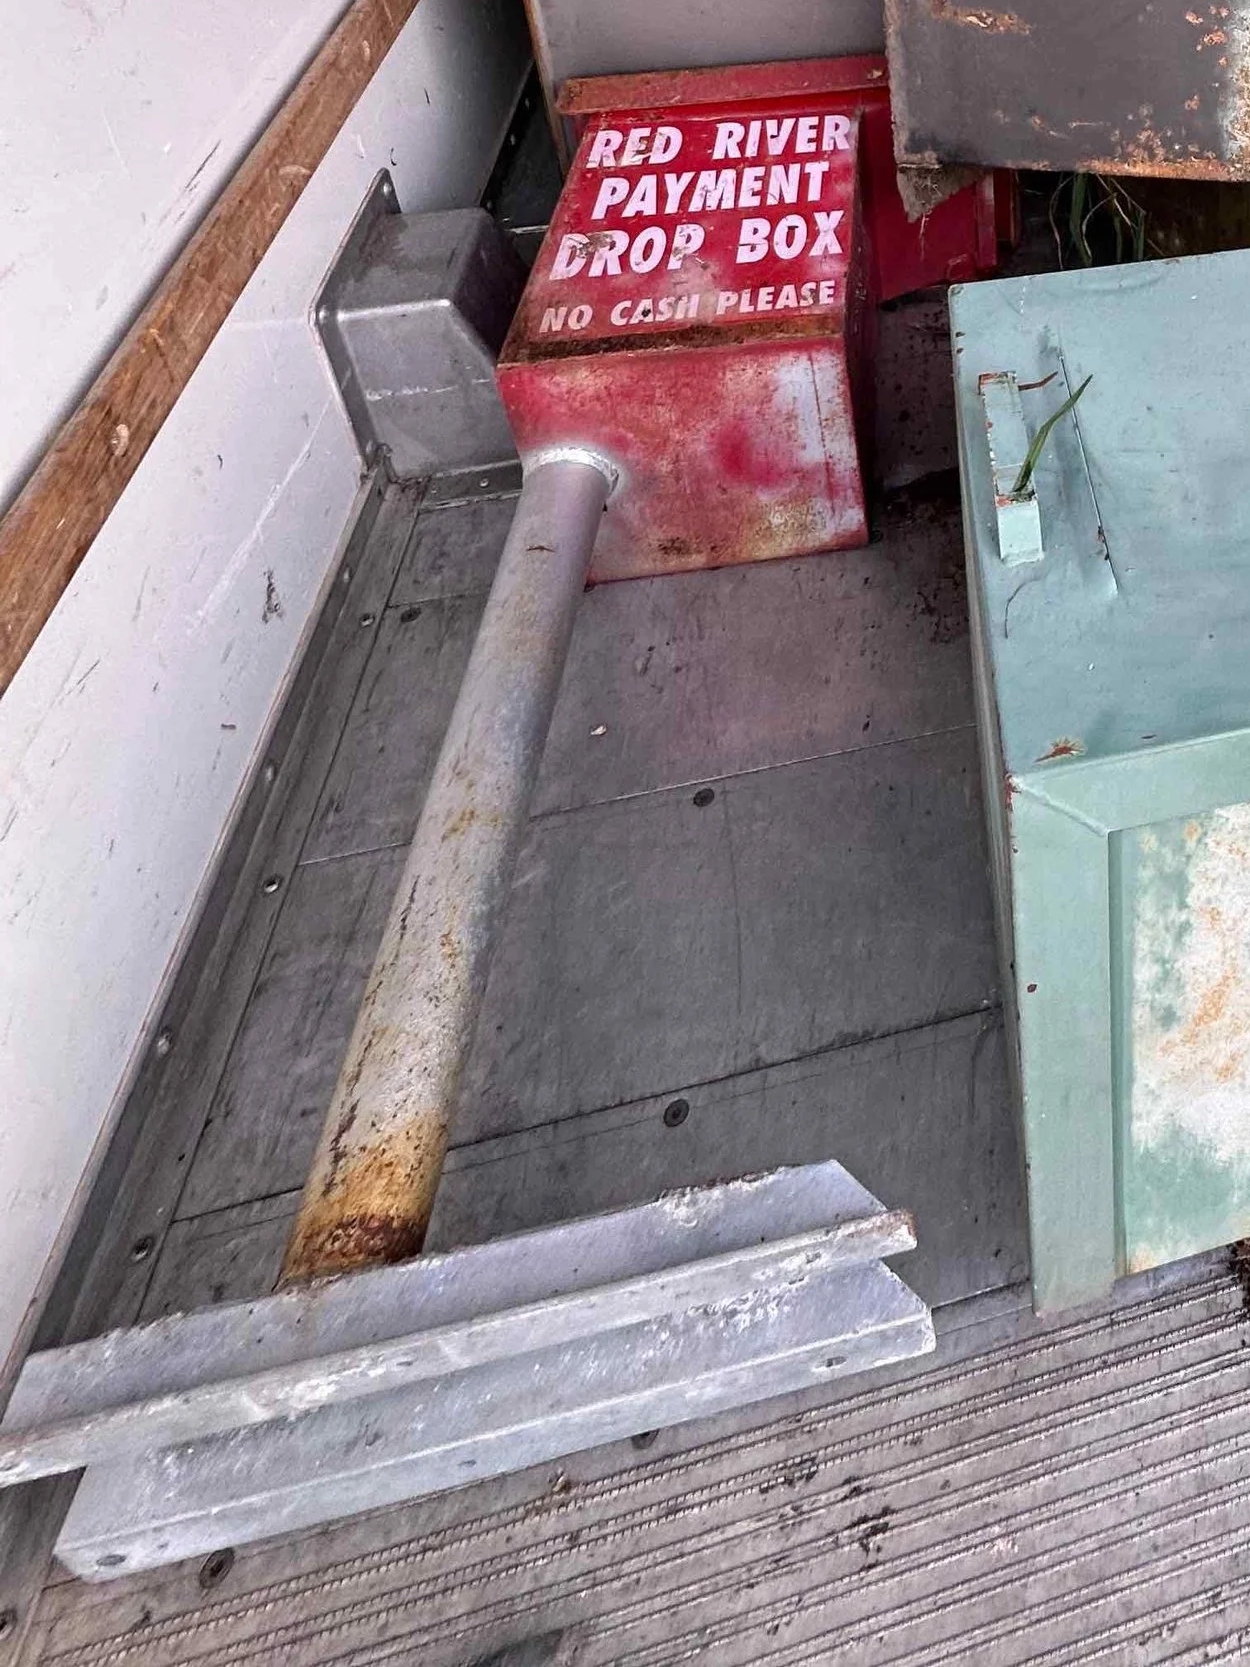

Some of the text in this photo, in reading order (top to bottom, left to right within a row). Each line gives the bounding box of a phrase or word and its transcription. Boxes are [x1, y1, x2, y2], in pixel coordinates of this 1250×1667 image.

[586, 115, 851, 169] RED RIVER
[591, 161, 831, 220] PAYMENT
[549, 210, 844, 280] DROP BOX
[539, 280, 836, 333] NO CASH PLEASE
